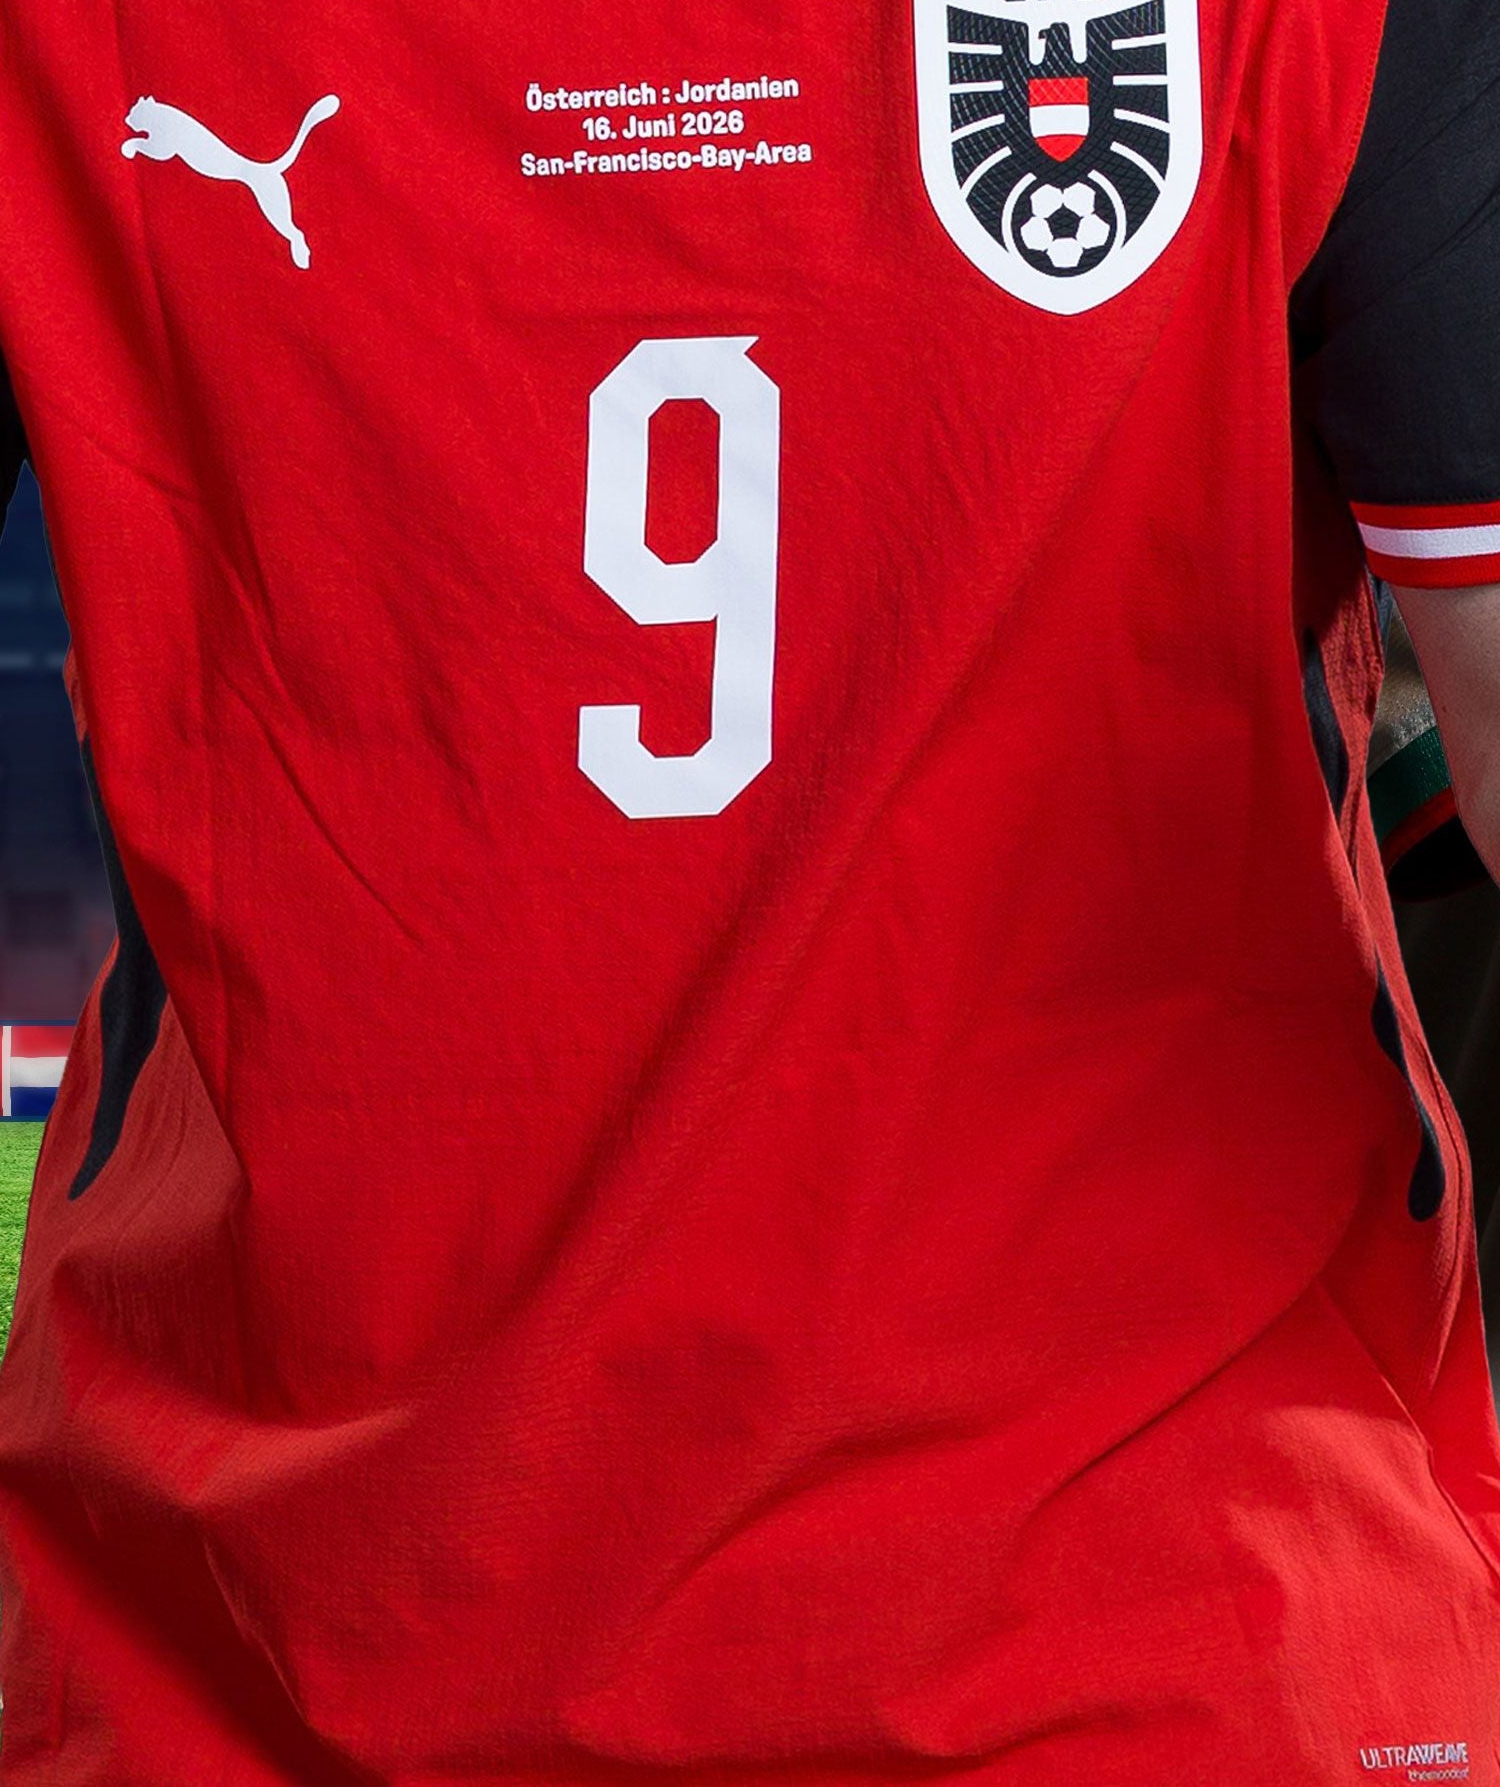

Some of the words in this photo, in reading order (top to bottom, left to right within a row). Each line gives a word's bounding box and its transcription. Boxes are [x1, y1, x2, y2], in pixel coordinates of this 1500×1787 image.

[525, 82, 656, 111] Österreich
[661, 86, 671, 105] :
[674, 76, 799, 104] Jordanien
[581, 116, 618, 141] 16.
[622, 113, 676, 139] Juni
[681, 109, 745, 137] 2026
[520, 140, 812, 176] San-Francisco-Bay-Area
[577, 336, 781, 820] 9
[1359, 1742, 1469, 1769] ULTRAWEAVE
